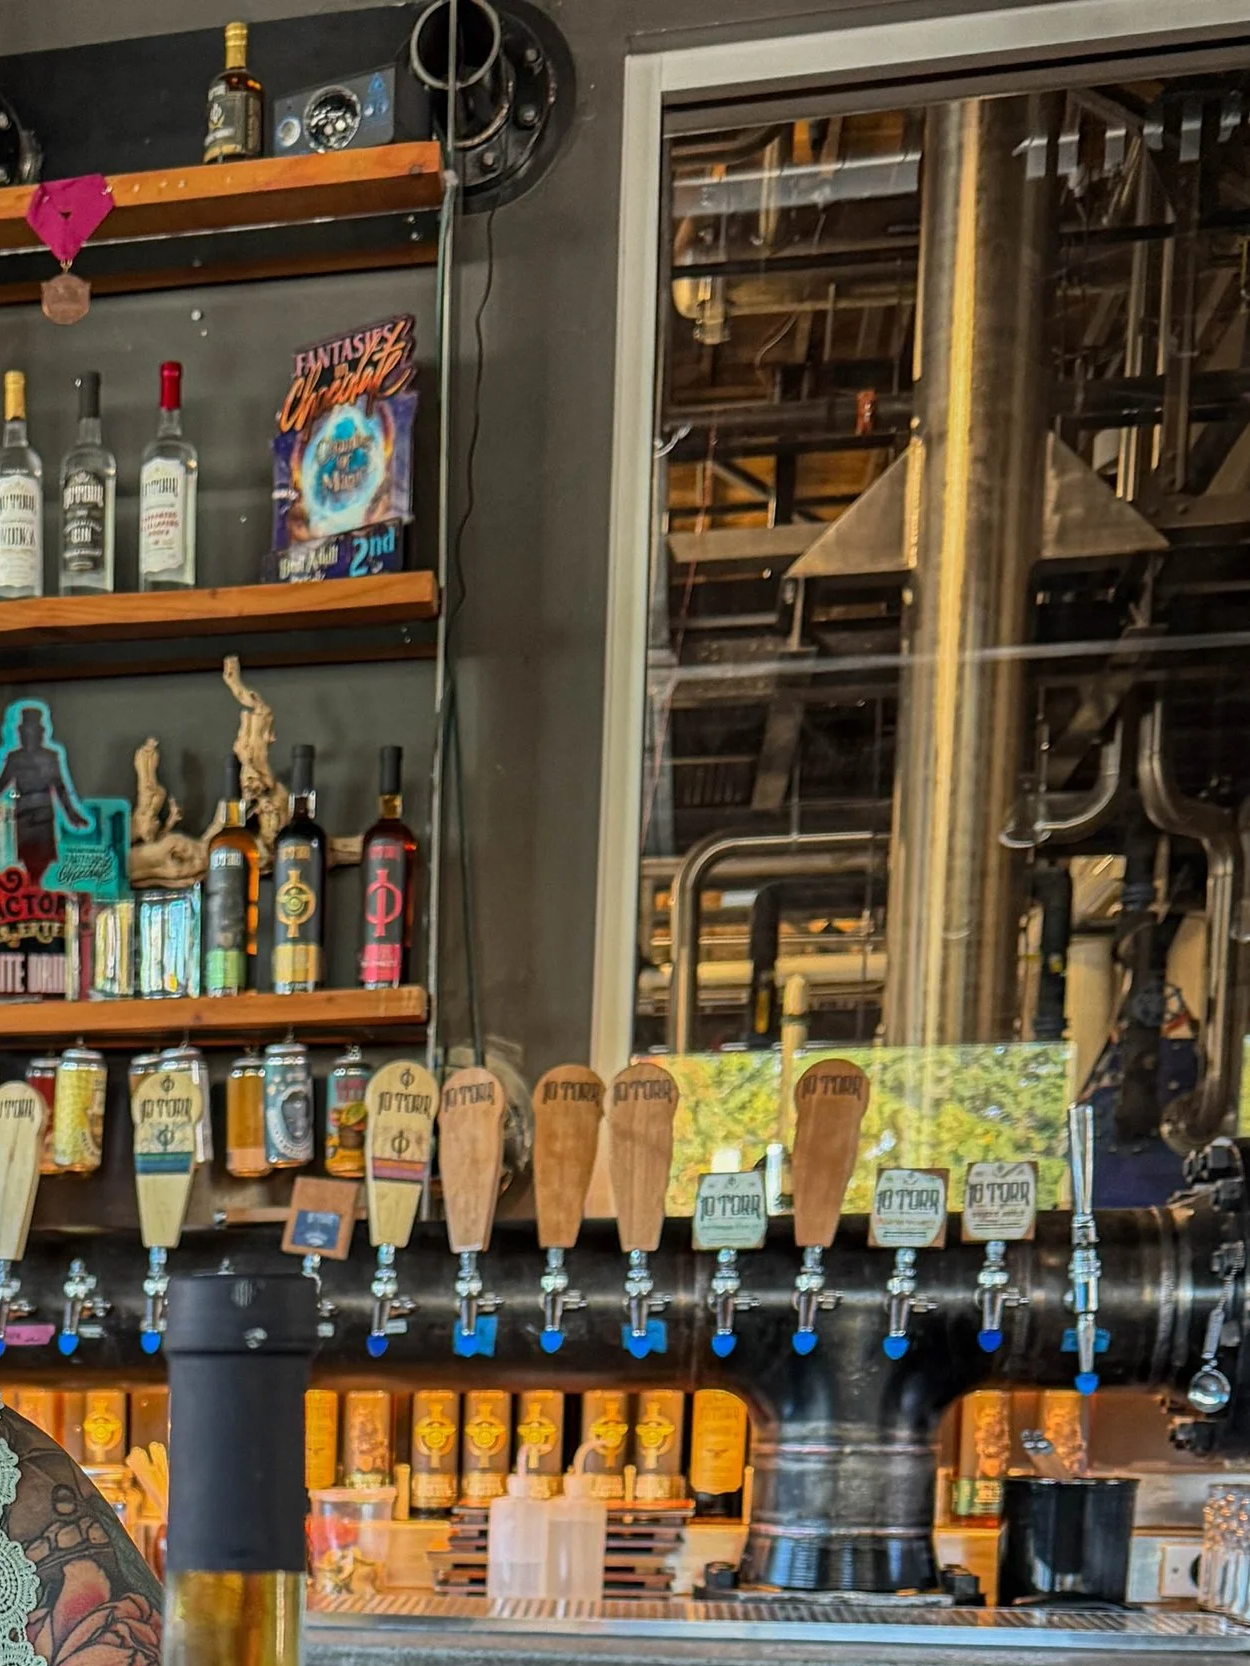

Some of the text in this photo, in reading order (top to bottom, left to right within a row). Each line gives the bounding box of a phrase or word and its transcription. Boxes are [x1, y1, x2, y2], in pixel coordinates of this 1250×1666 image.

[350, 526, 396, 577] 2nd
[700, 1194, 762, 1221] 10 TORR
[876, 1186, 894, 1215] 10
[895, 1188, 940, 1215] TORR
[968, 1181, 1031, 1209] 10 TORR
